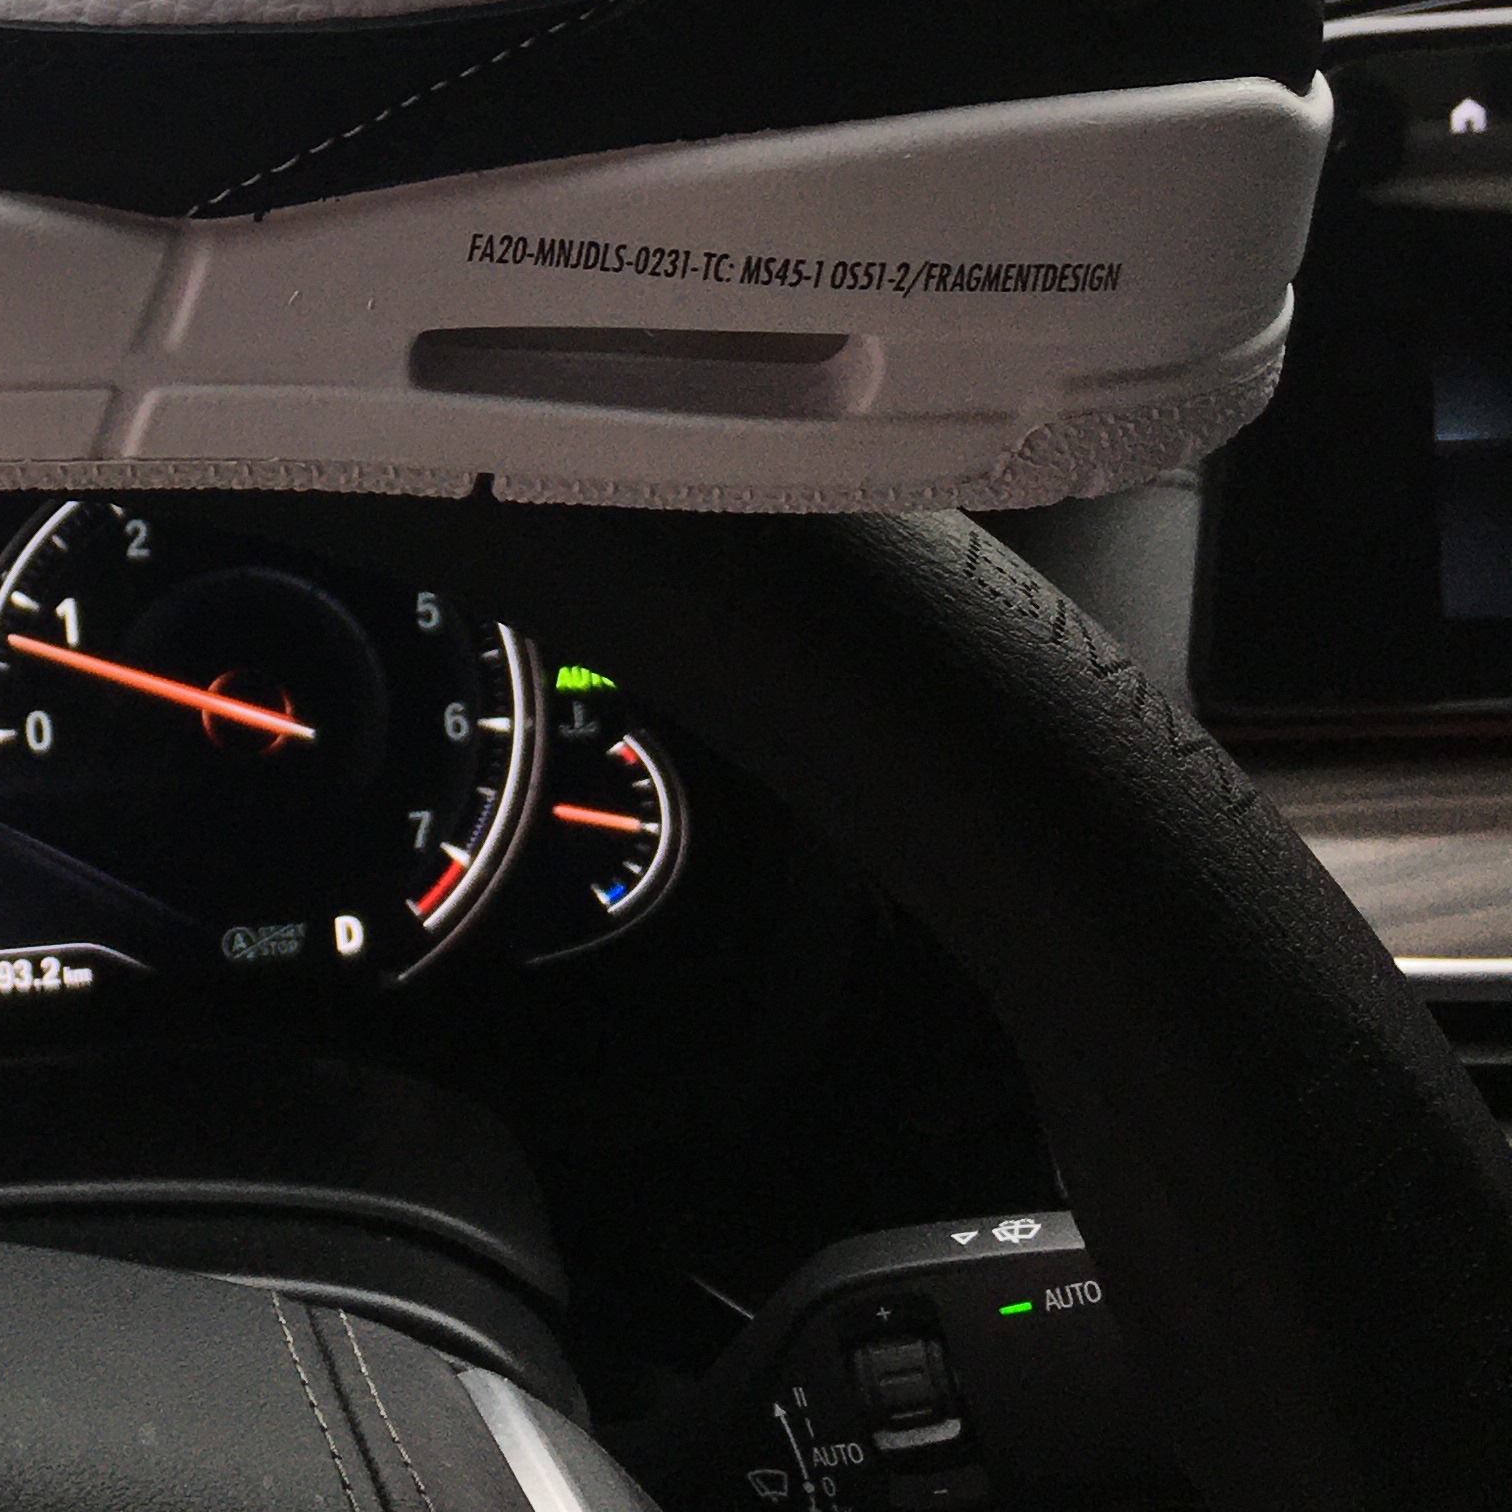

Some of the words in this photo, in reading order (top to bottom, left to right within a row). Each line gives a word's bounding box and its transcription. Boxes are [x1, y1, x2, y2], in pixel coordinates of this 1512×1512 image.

[739, 254, 823, 288] MS45-1
[126, 519, 150, 558] 2
[56, 597, 80, 647] 1
[416, 591, 441, 630] 5
[26, 710, 53, 752] 0
[444, 703, 470, 741] 6
[408, 810, 433, 849] 7
[334, 914, 365, 956] D
[1044, 1280, 1102, 1312] AUTO
[813, 1442, 864, 1467] AUTO
